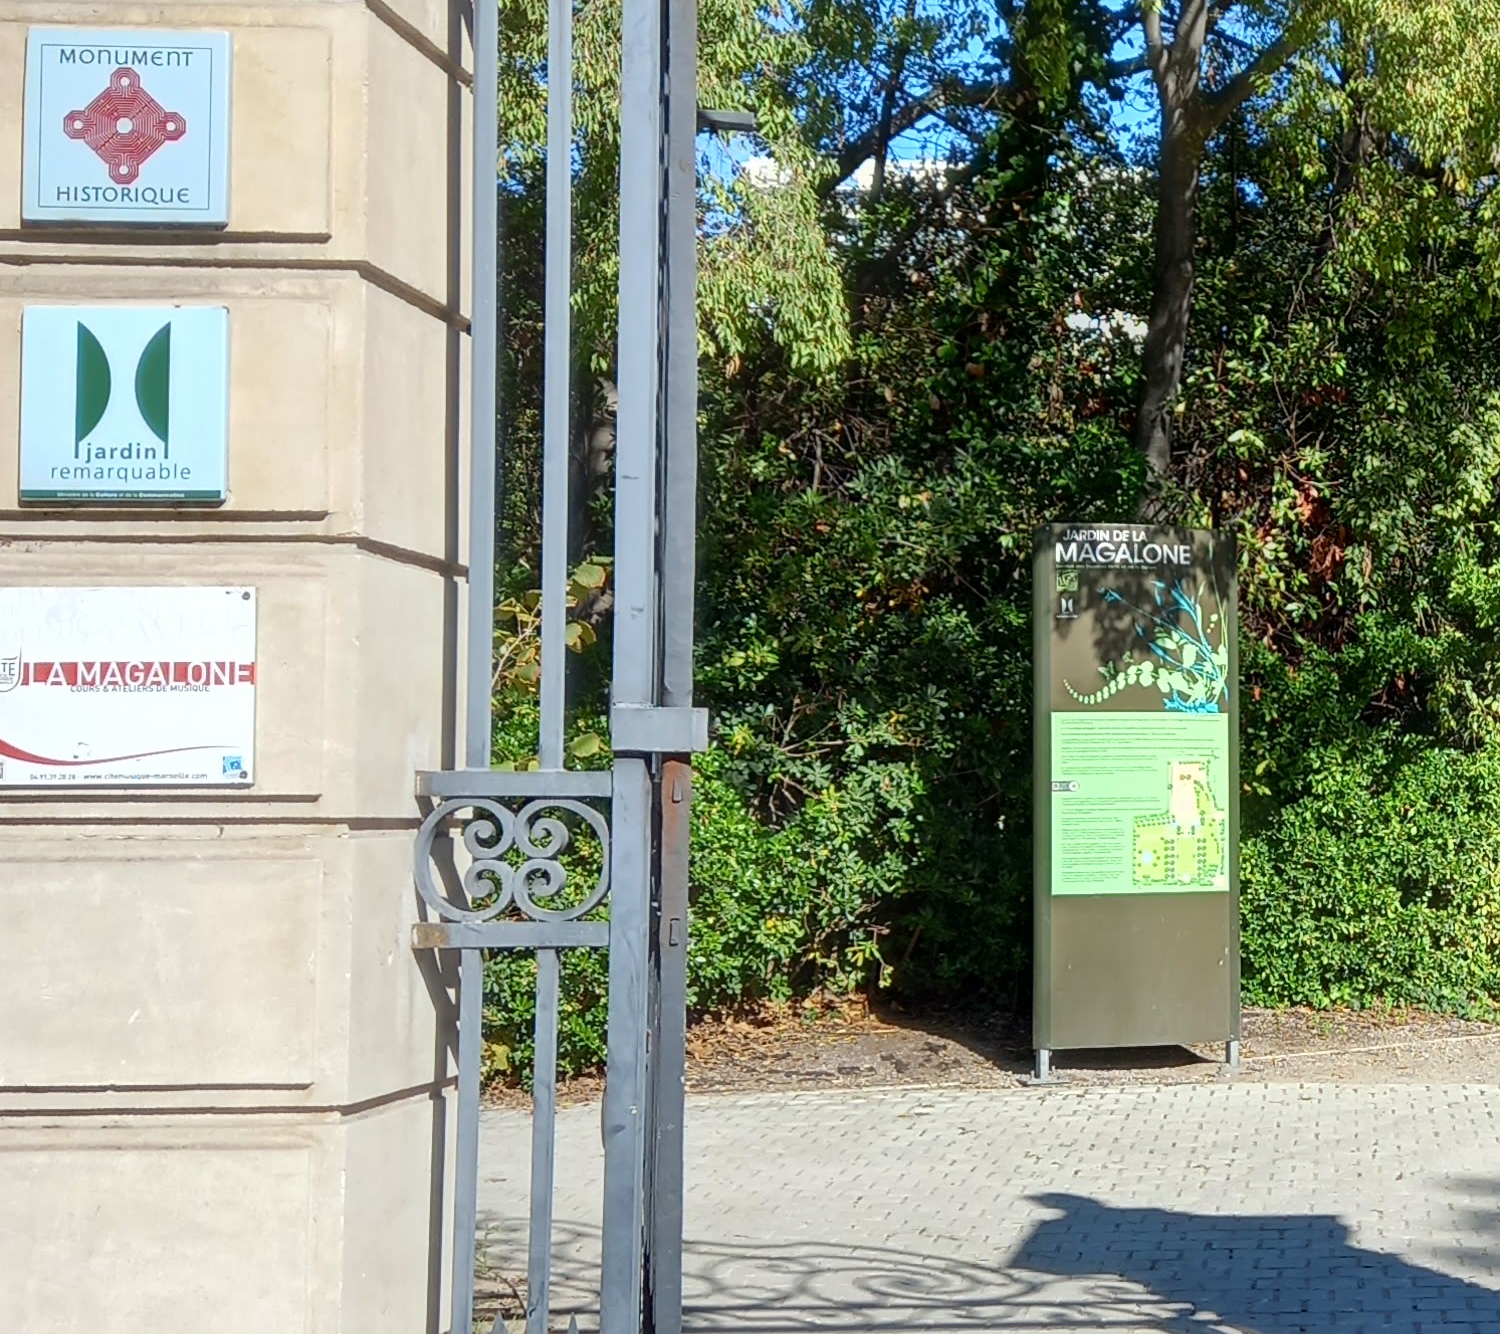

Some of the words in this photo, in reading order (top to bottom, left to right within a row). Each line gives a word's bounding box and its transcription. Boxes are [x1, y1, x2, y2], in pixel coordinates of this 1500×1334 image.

[59, 48, 194, 67] MONUMENT
[56, 186, 190, 204] HISTORIQUE
[84, 442, 157, 463] jardin
[50, 463, 192, 483] remarquable
[1062, 529, 1110, 541] JARDIN
[1113, 529, 1129, 542] DE
[1132, 530, 1148, 542] LA
[1055, 541, 1191, 565] MAGALONE
[28, 661, 68, 686] LA
[77, 661, 251, 685] MAGALONE
[70, 683, 101, 692] COURS
[102, 684, 108, 692] &
[111, 683, 154, 692] ATELIERS
[156, 684, 168, 692] DE
[170, 683, 210, 692] MUSIQUE
